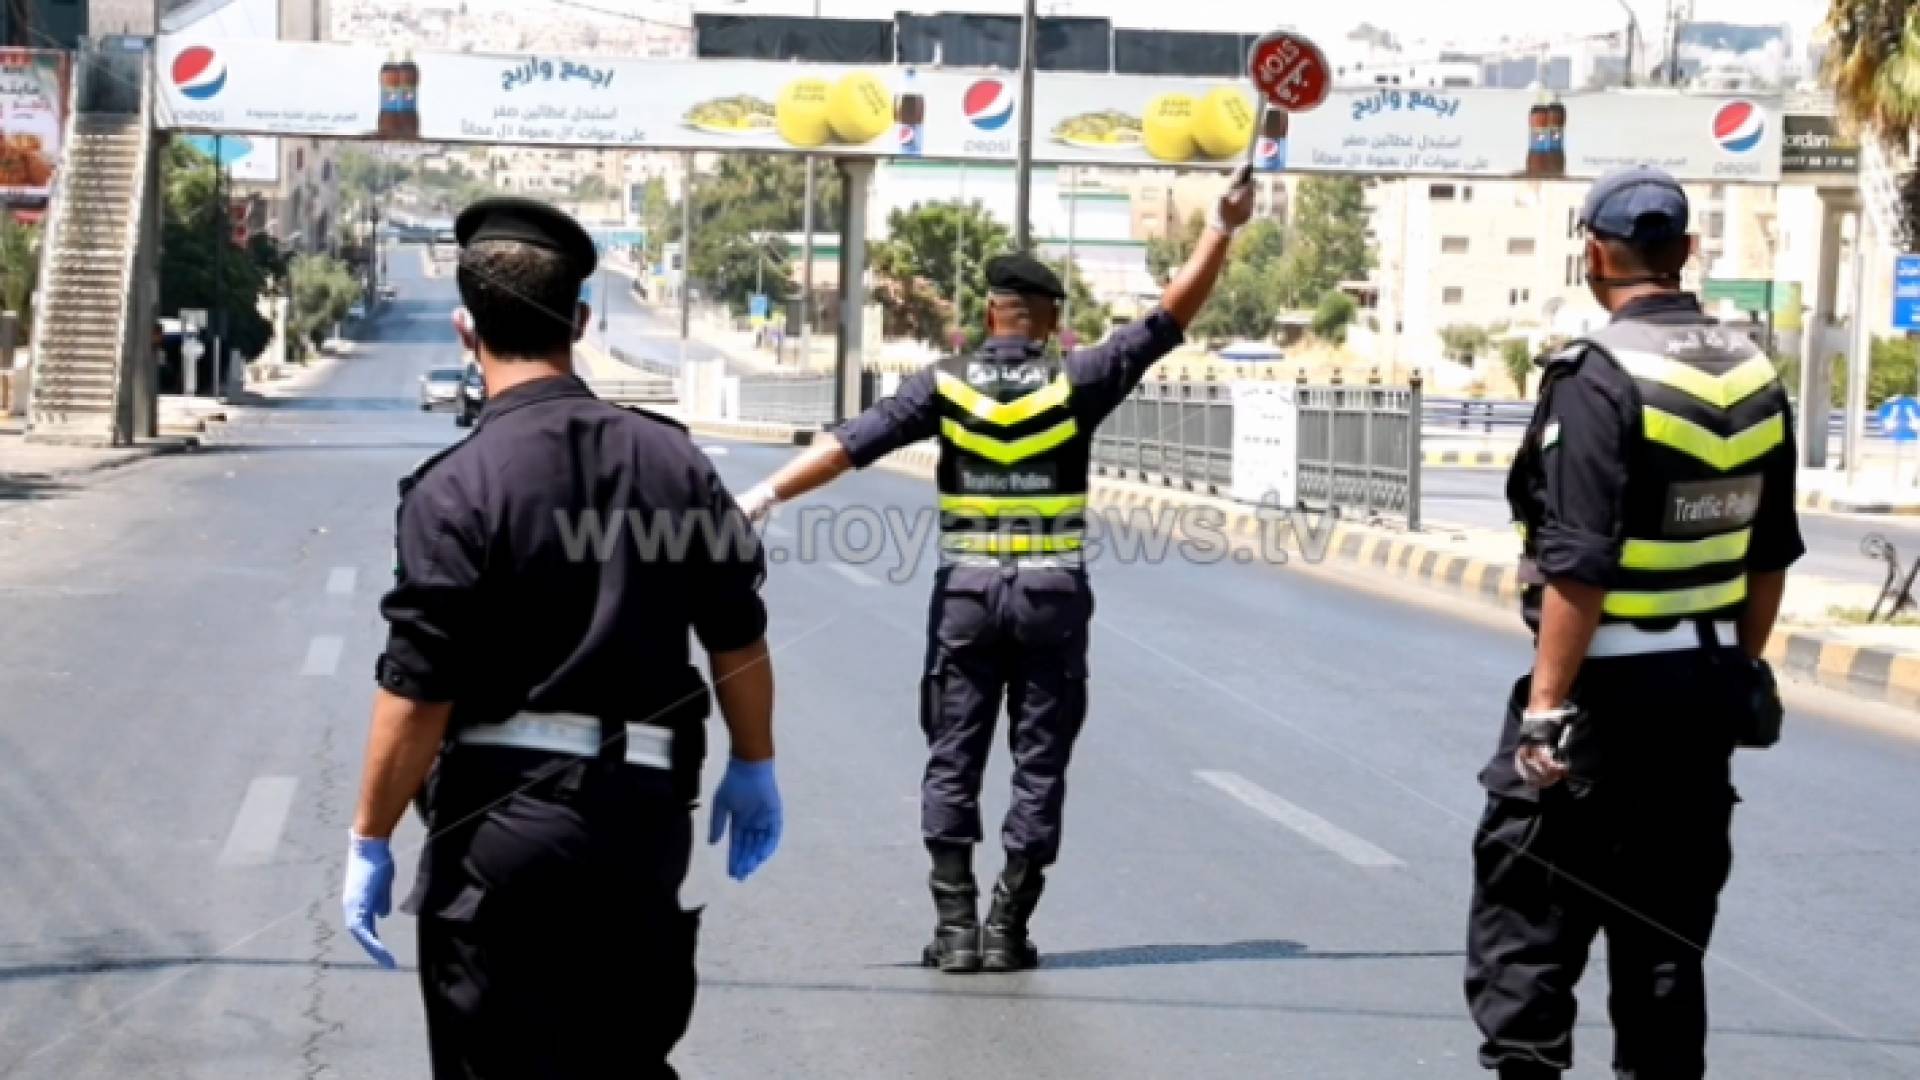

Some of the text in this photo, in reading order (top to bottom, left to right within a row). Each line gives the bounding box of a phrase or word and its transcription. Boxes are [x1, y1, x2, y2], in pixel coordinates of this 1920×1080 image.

[559, 60, 614, 90] اجمع
[1258, 39, 1300, 84] STOP
[1407, 90, 1461, 119] اجمع
[1782, 128, 1830, 149] ordan
[1675, 494, 1723, 521] Traffic
